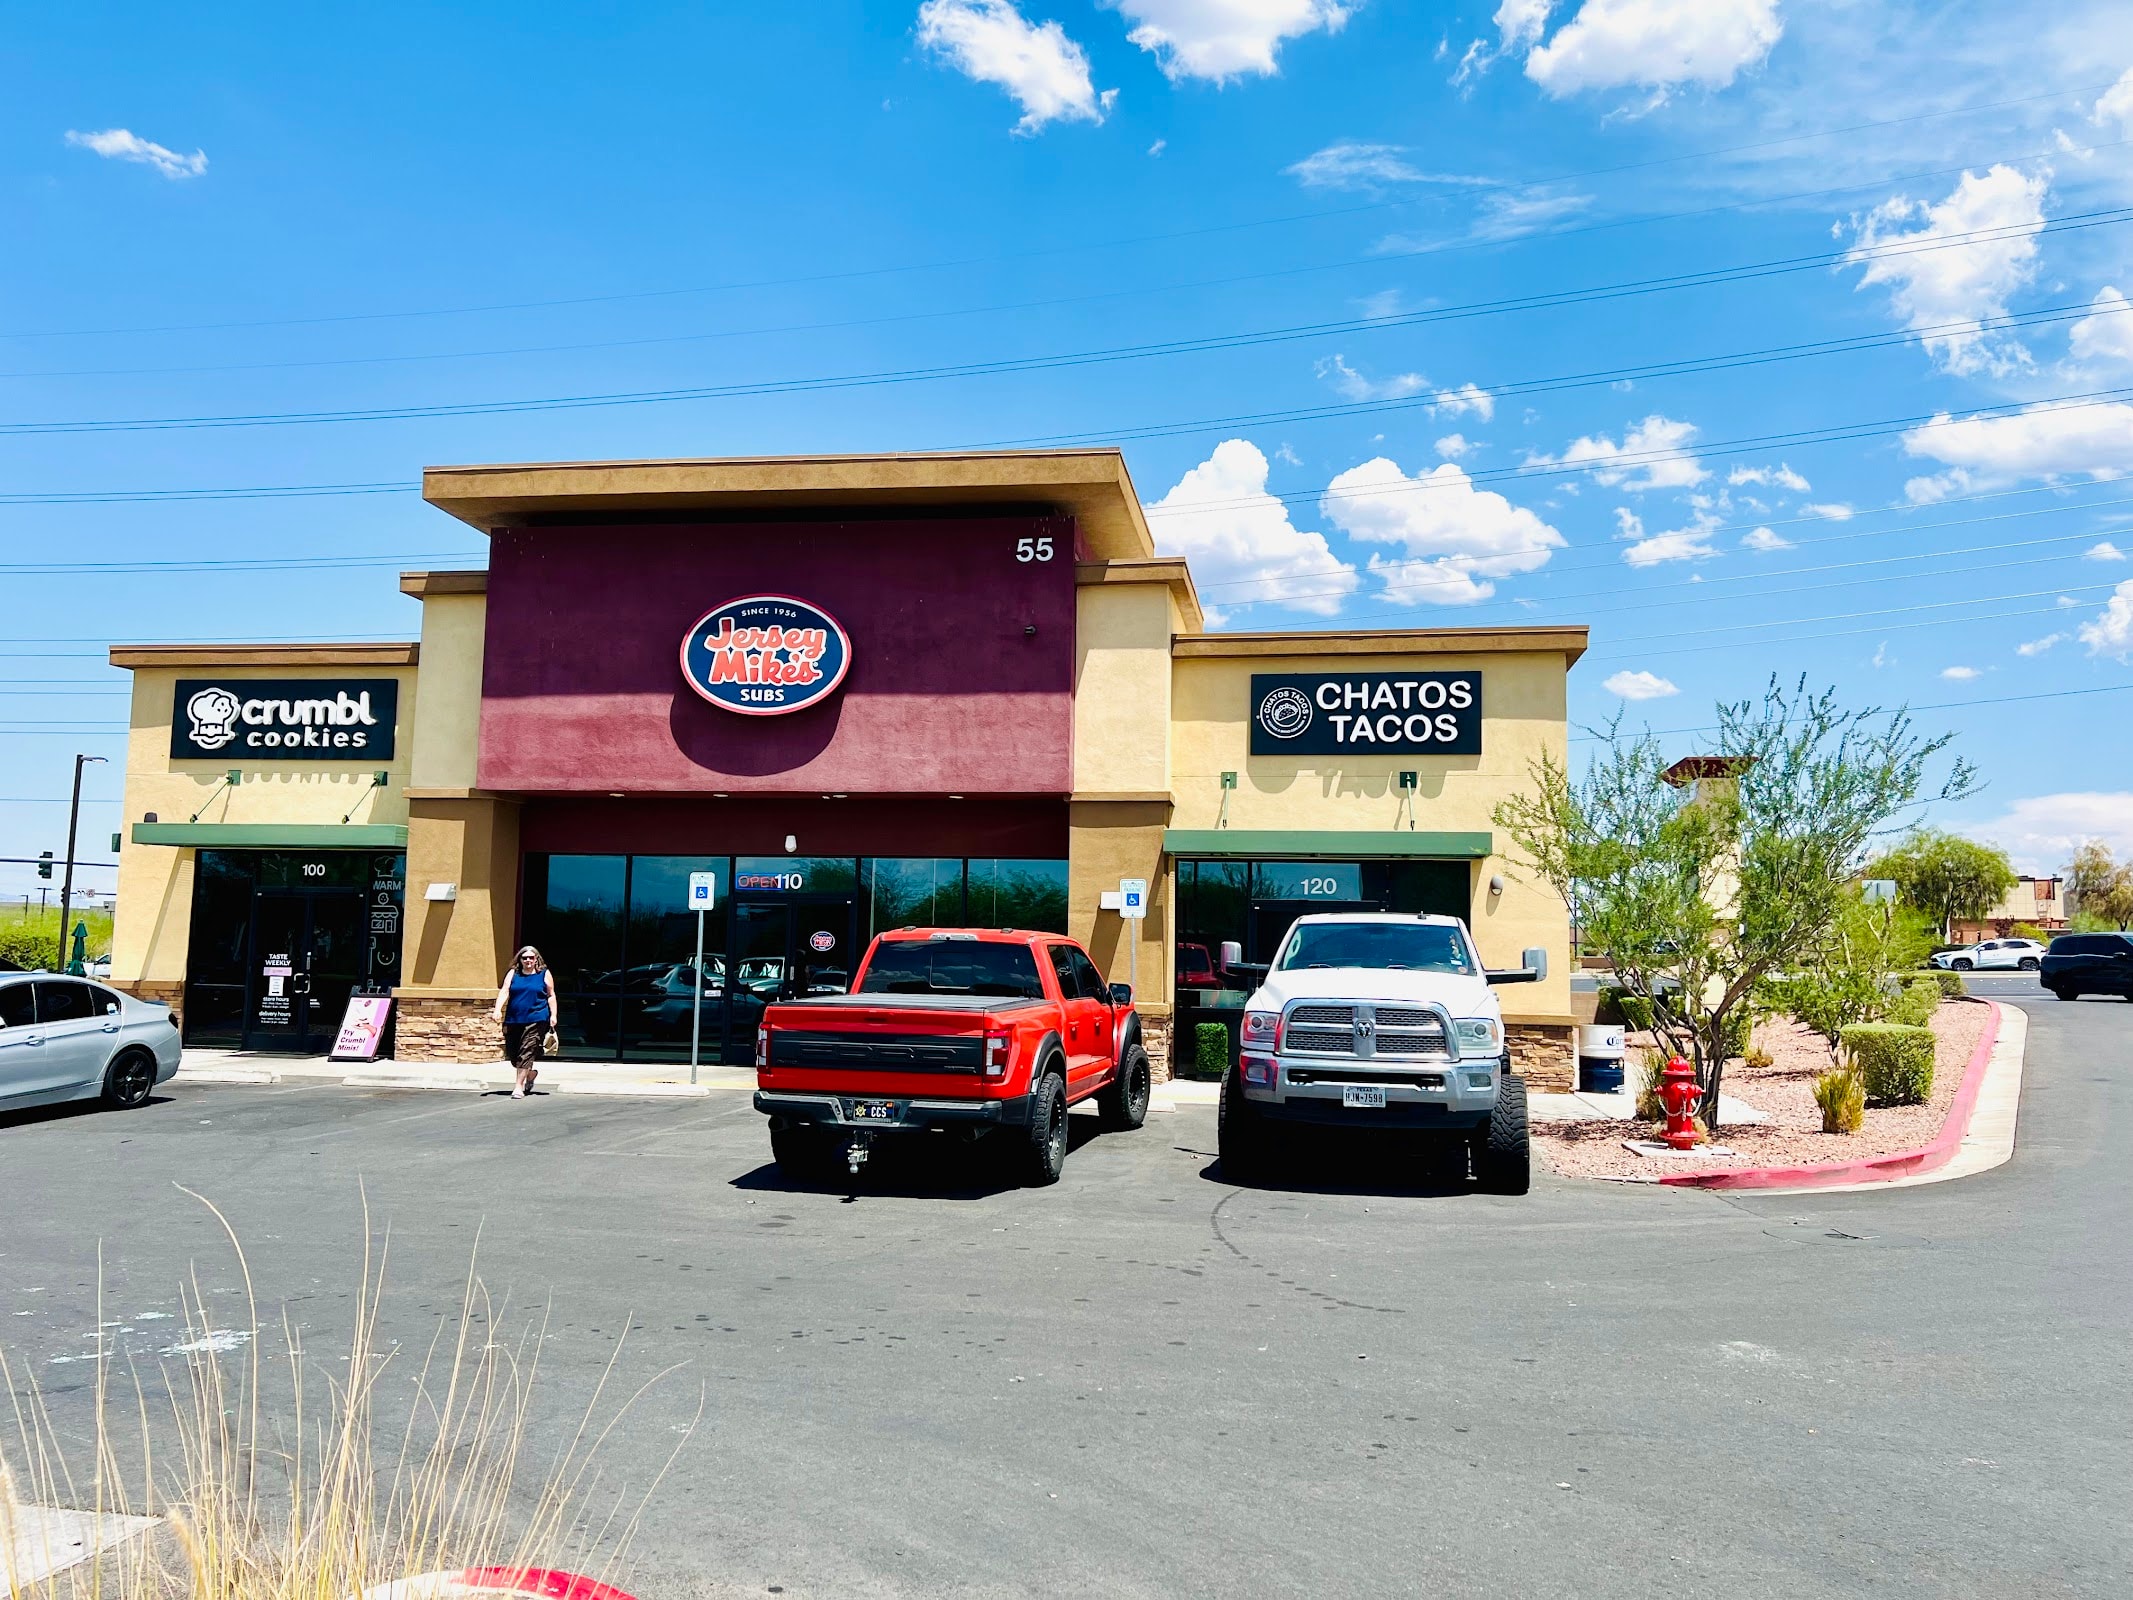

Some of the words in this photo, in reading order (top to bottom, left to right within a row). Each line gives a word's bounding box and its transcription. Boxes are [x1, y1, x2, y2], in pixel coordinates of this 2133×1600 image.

[1016, 537, 1054, 562] 55
[741, 607, 769, 617] SINCE
[774, 607, 797, 618] 1956
[705, 618, 826, 659] Jersey
[710, 651, 822, 685] Mike's
[740, 689, 785, 702] SUBS
[1263, 690, 1290, 714] CHATOS
[1290, 691, 1309, 715] TACOS
[1315, 680, 1473, 710] CHATOS
[241, 691, 378, 726] crumbl
[247, 726, 367, 748] cookies
[1328, 714, 1458, 743] TACOS
[302, 864, 326, 876] 100
[373, 880, 401, 890] WARM
[738, 875, 778, 888] OPEN
[774, 873, 803, 889] 110
[1301, 877, 1337, 895] 120
[344, 1029, 355, 1037] Try
[871, 1106, 887, 1118] CCS
